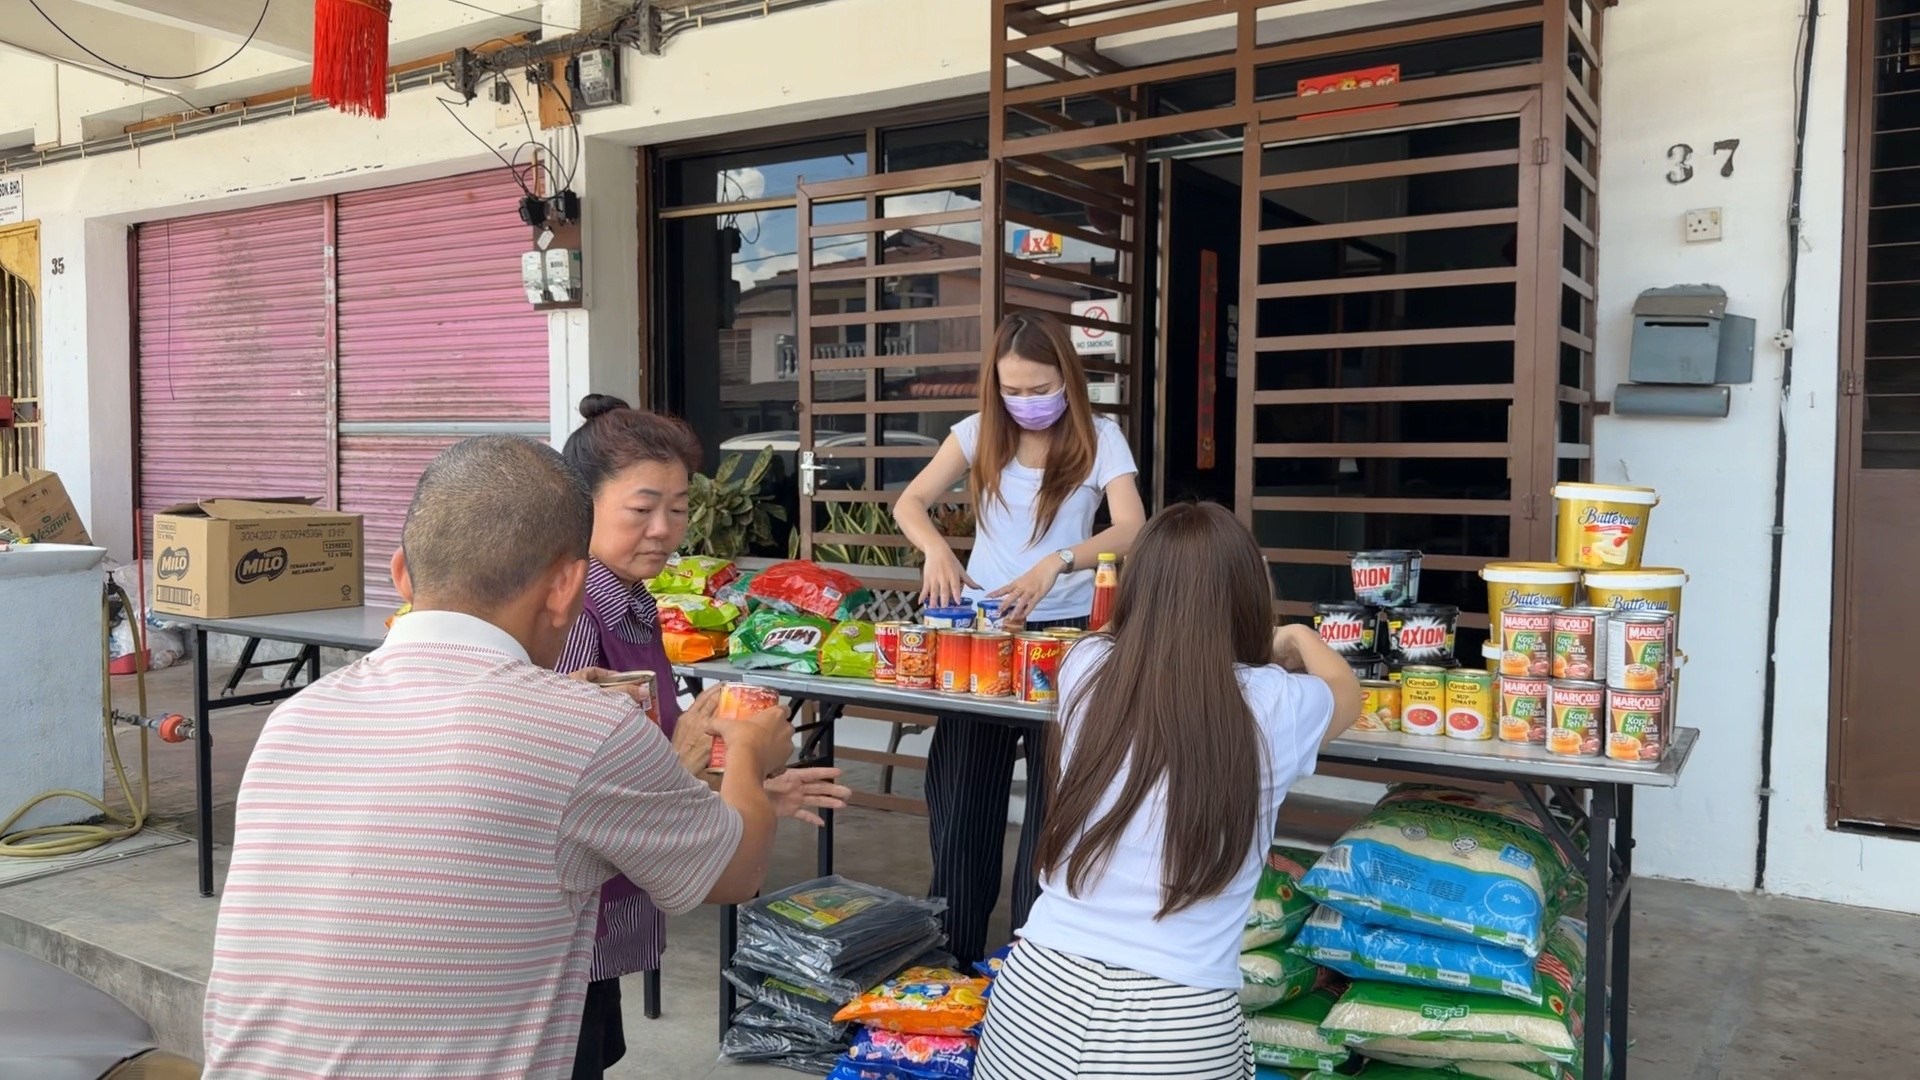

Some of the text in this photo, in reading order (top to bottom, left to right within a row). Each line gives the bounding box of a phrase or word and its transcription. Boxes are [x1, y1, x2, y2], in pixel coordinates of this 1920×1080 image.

[51, 257, 65, 275] 35
[1086, 340, 1114, 348] SMOKING
[1578, 506, 1640, 526] Buttercup
[161, 556, 188, 572] MILO
[242, 557, 282, 576] MILO
[1503, 588, 1562, 607] Buttercup
[1504, 616, 1550, 629] MARIGOLD
[1321, 621, 1363, 643] AXION
[1401, 626, 1446, 648] AXION
[1408, 679, 1438, 687] Kimball
[1450, 683, 1479, 691] Kimball
[1554, 691, 1600, 705] MARIGOLD
[1612, 695, 1661, 710] MARIGOLD
[1568, 711, 1587, 721] Kopi
[1627, 716, 1646, 726] Kopi
[1624, 724, 1640, 733] Teh
